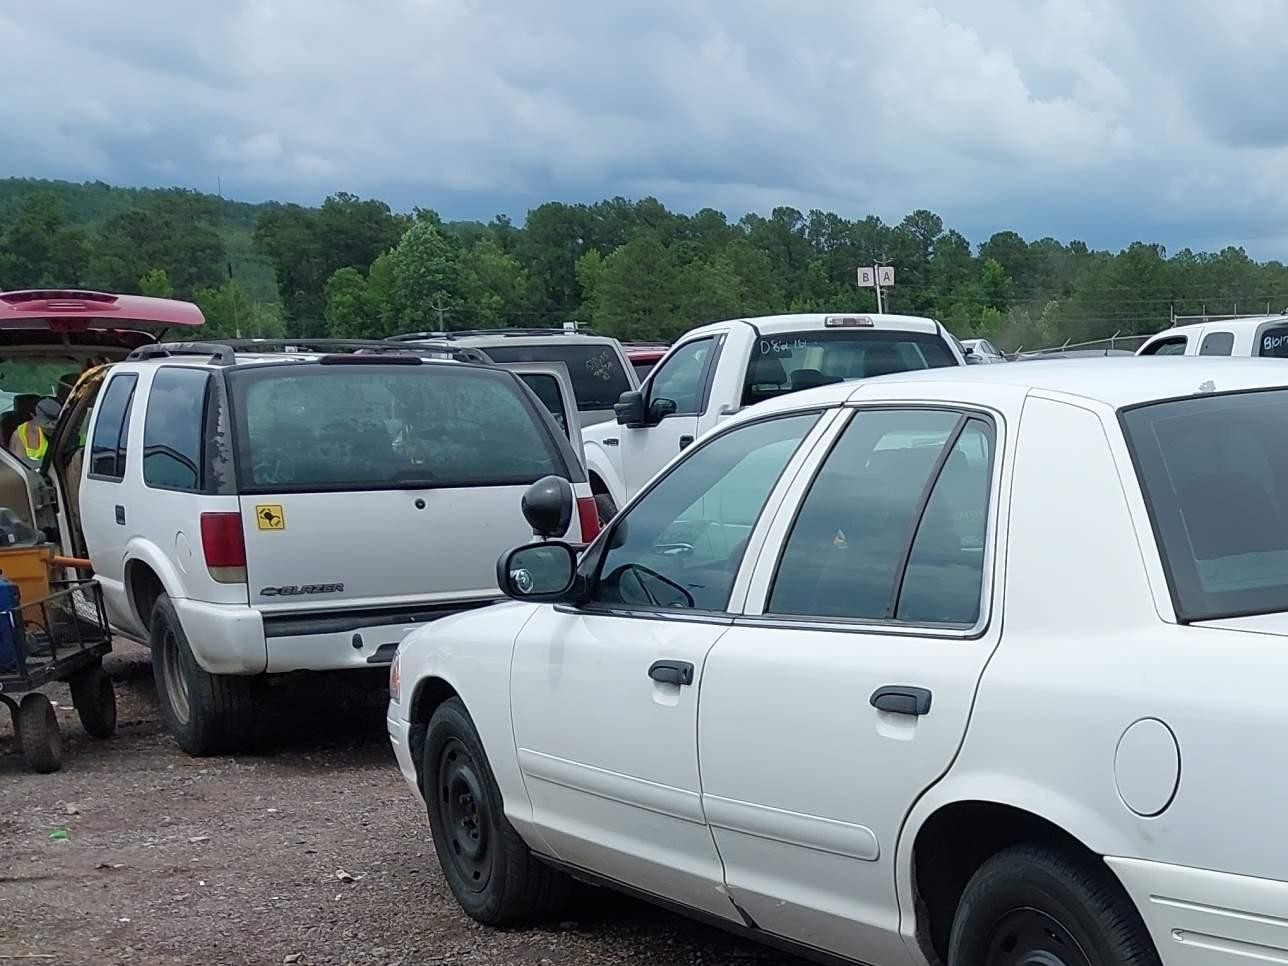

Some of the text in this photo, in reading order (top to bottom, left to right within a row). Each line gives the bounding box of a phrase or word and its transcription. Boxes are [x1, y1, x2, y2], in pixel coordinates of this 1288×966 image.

[863, 272, 870, 282] B
[883, 272, 890, 282] A
[280, 583, 345, 596] BLAZER
